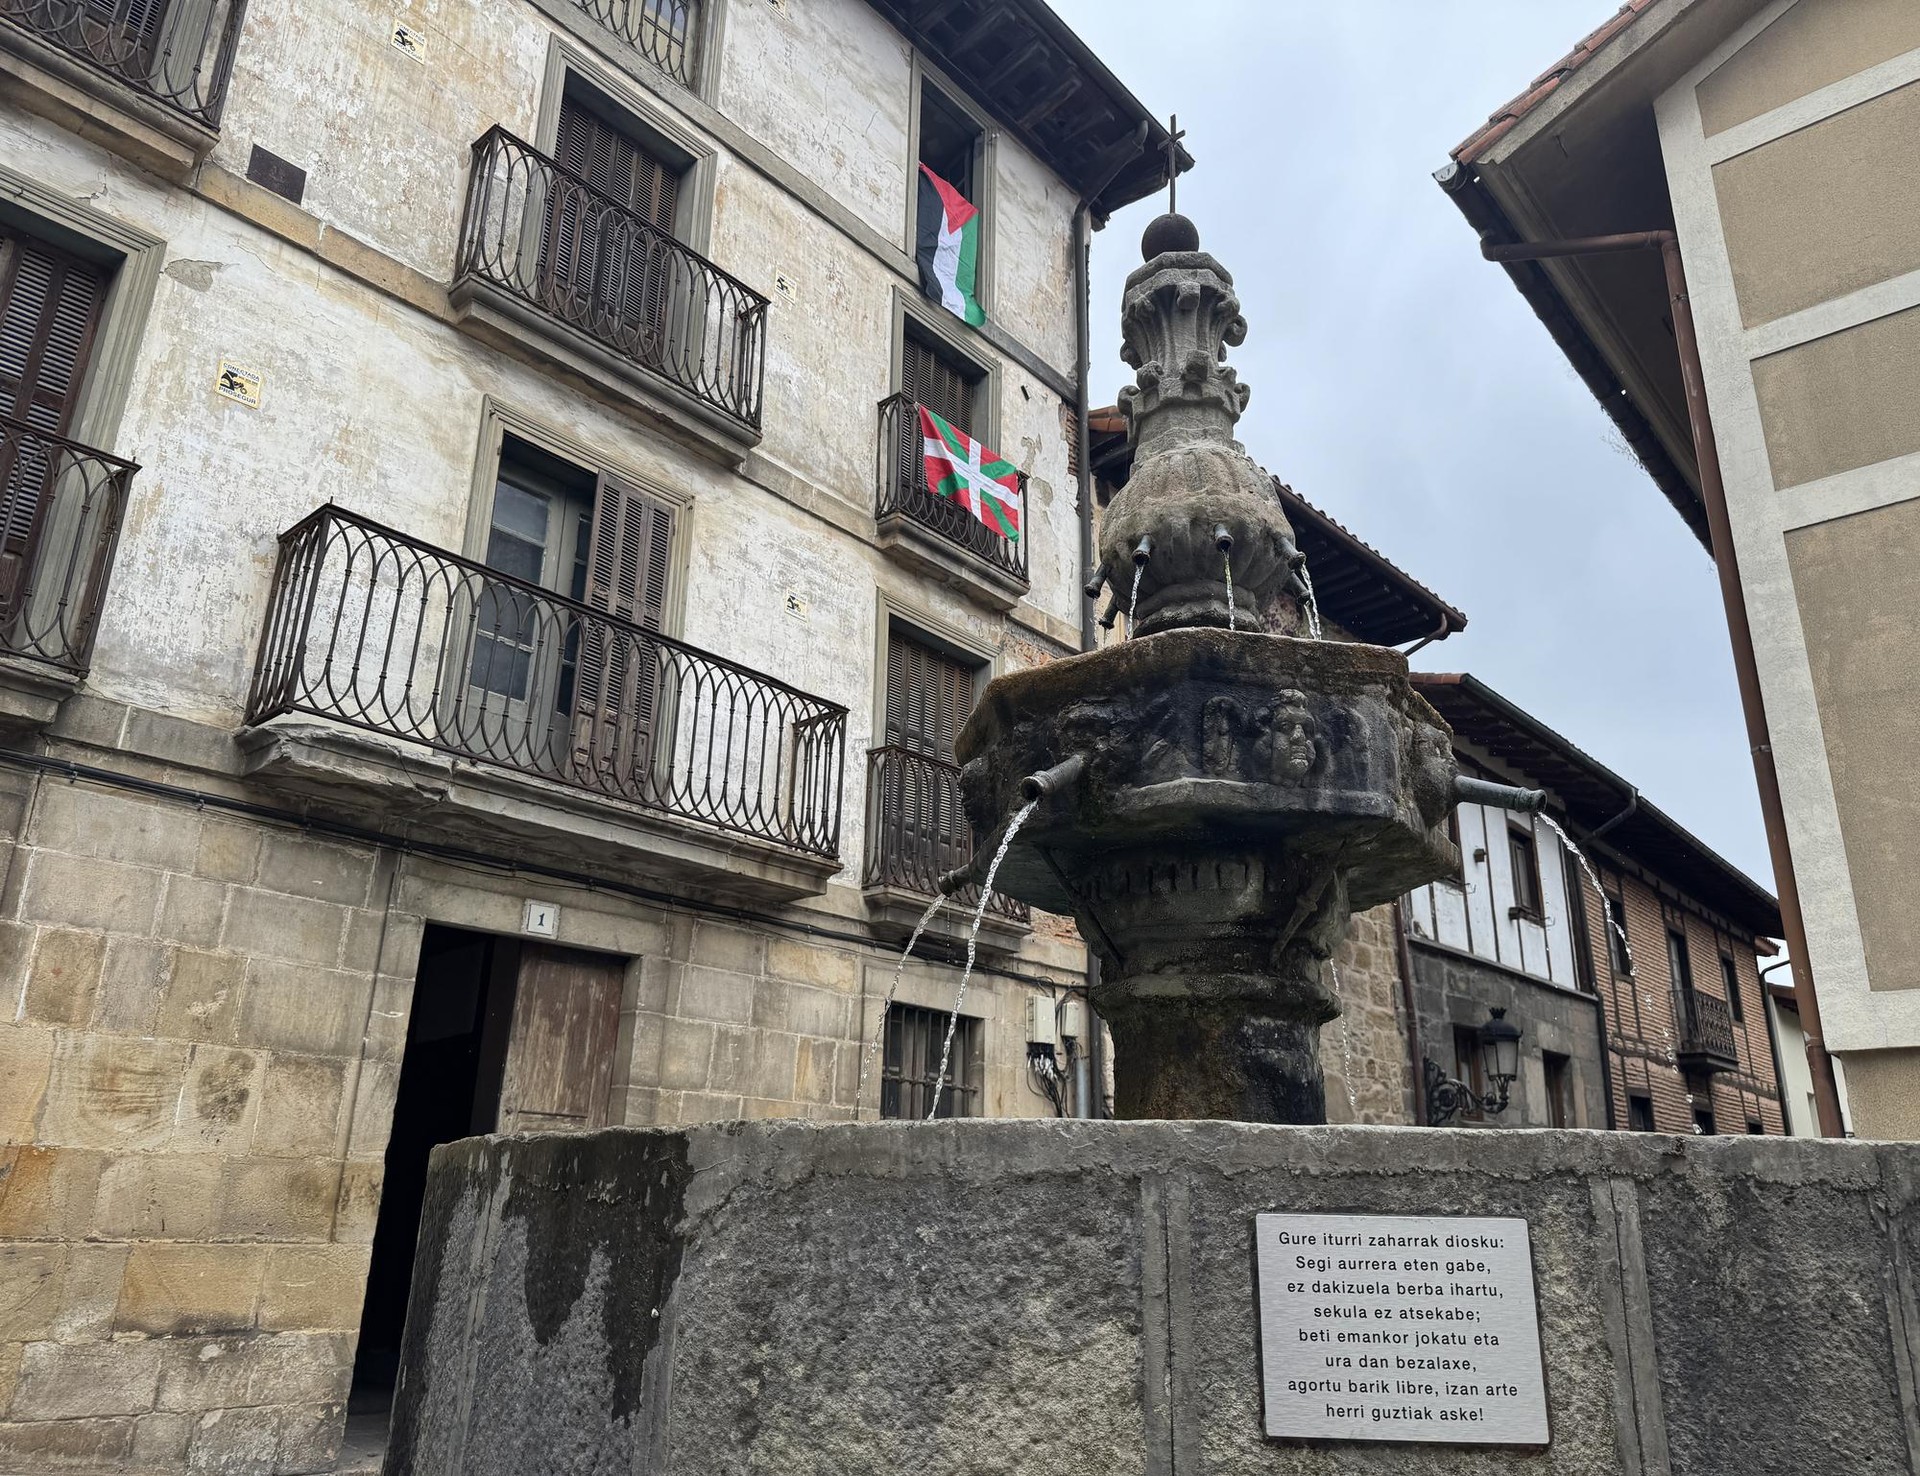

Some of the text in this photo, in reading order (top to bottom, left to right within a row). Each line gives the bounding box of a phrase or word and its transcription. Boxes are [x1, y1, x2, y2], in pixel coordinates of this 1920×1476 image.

[218, 386, 256, 404] PROSEGUR
[537, 912, 545, 927] 1
[1278, 1231, 1504, 1249] Gure iturri zaharrak diosku:
[1295, 1255, 1491, 1275] Segi aurrera eten gabe,
[1287, 1279, 1503, 1299] ez dakizuela berba ihartu,
[1313, 1304, 1480, 1323] sekula ez atsekabe;
[1298, 1328, 1500, 1348] beti emankor jokatu eta
[1325, 1354, 1477, 1373] ura dan bezalaxe,
[1288, 1378, 1518, 1398] agortu barik libre, izan arte
[1325, 1403, 1484, 1422] herri guztiak aske!
